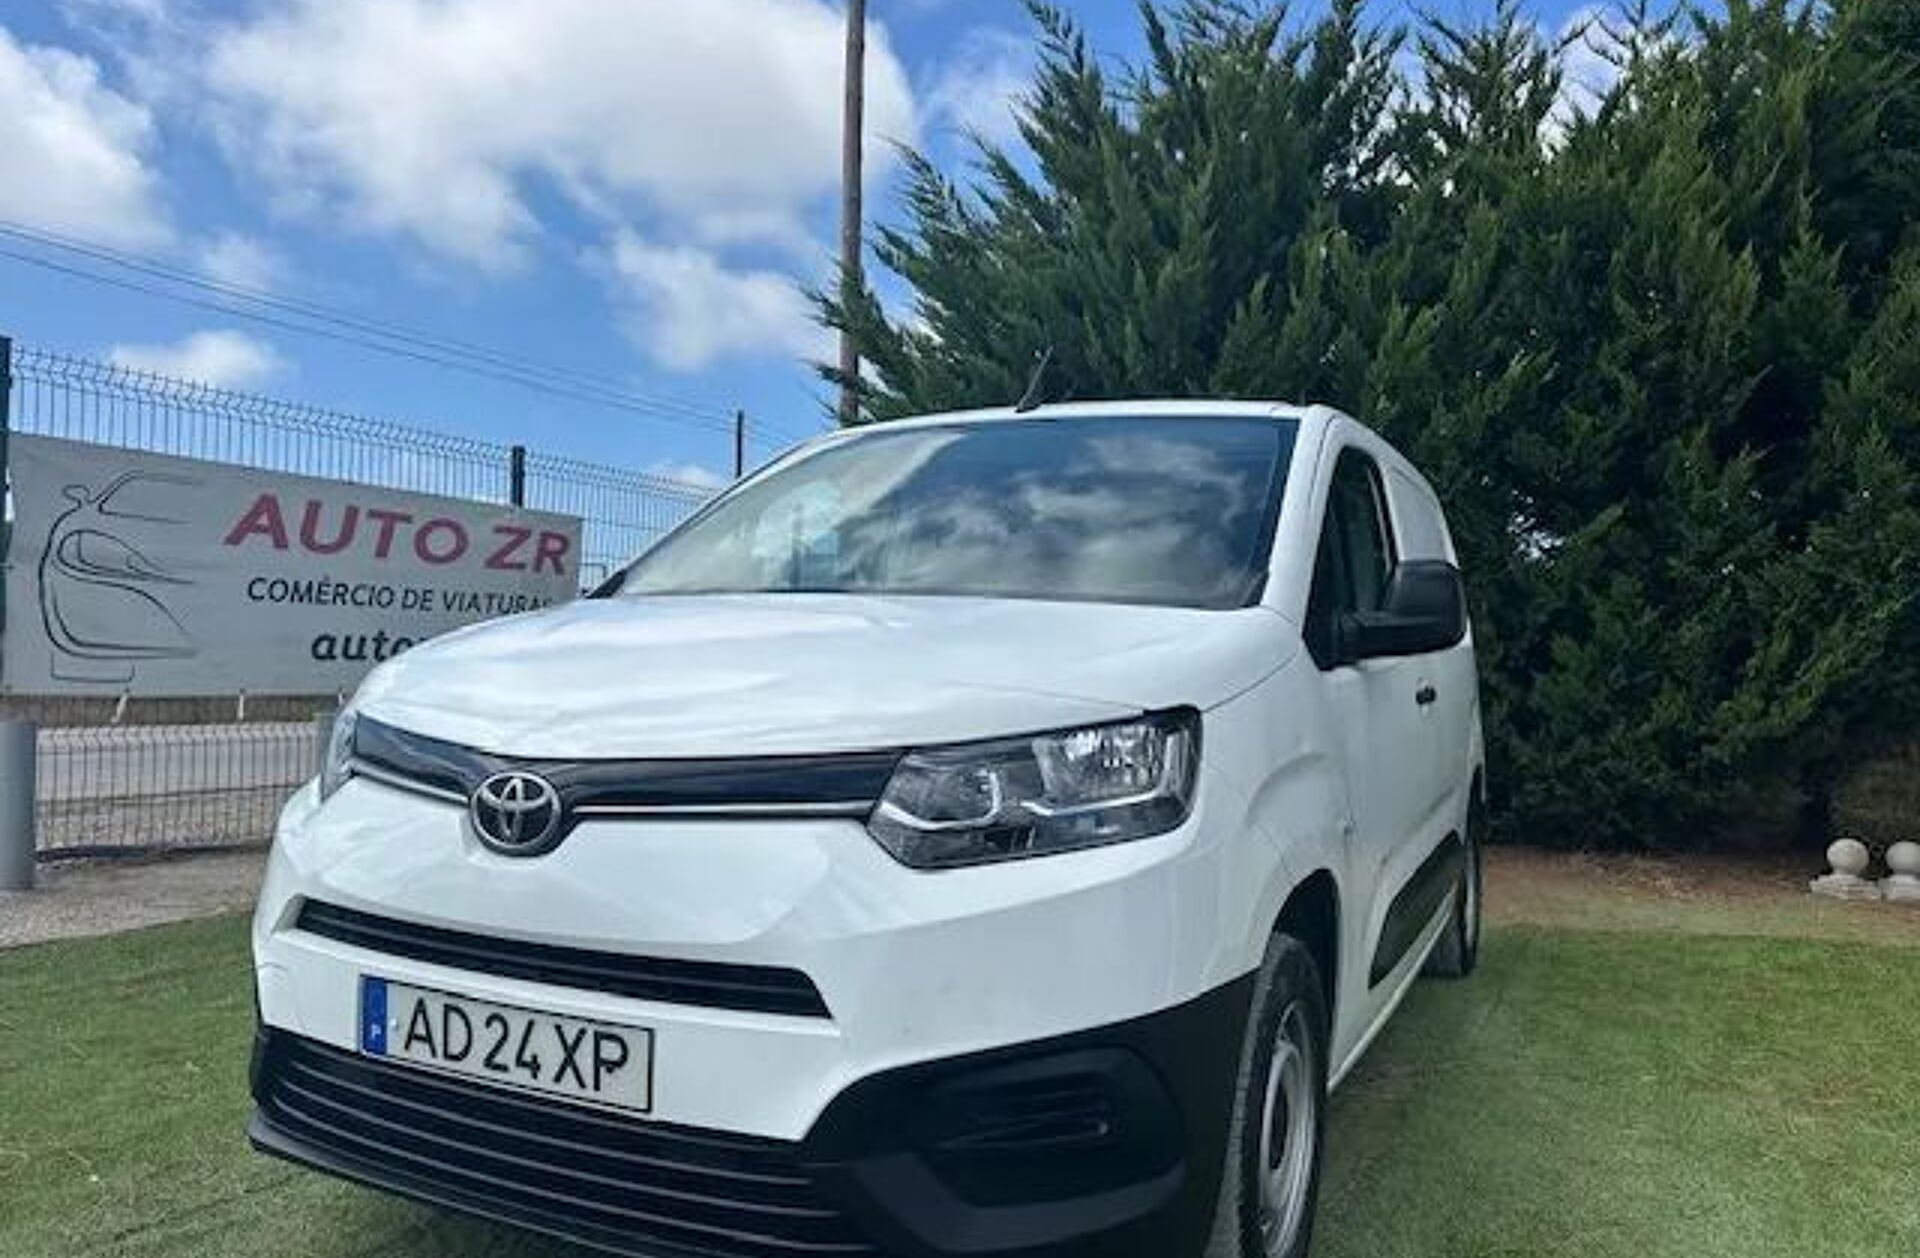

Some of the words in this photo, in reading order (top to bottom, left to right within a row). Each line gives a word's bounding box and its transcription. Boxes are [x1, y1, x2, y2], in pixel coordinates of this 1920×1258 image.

[224, 493, 468, 564] AUTO
[484, 524, 570, 575] ZR
[248, 574, 395, 608] COMÉRCIO
[401, 589, 433, 612] DE
